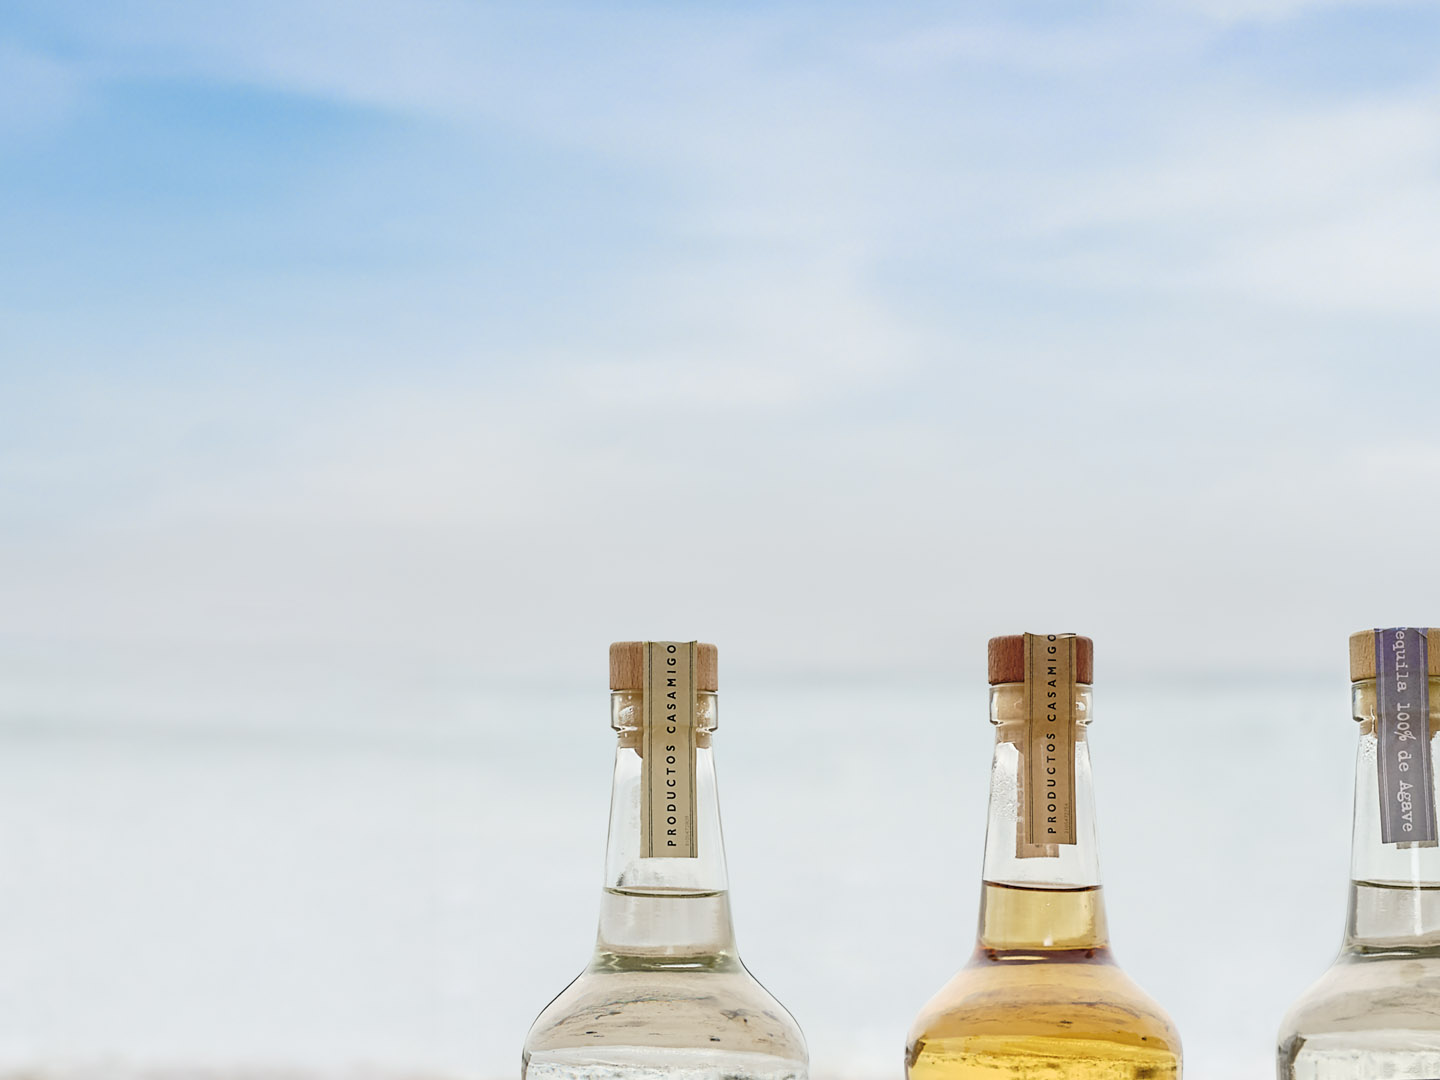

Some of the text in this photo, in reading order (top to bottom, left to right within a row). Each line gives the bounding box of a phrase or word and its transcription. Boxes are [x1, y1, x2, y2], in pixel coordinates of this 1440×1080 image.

[1394, 703, 1416, 741] 100%
[1046, 733, 1057, 834] PRODUCTOS
[1397, 750, 1412, 772] de
[666, 745, 677, 847] PRODUCTOS
[1396, 780, 1414, 833] Agave
